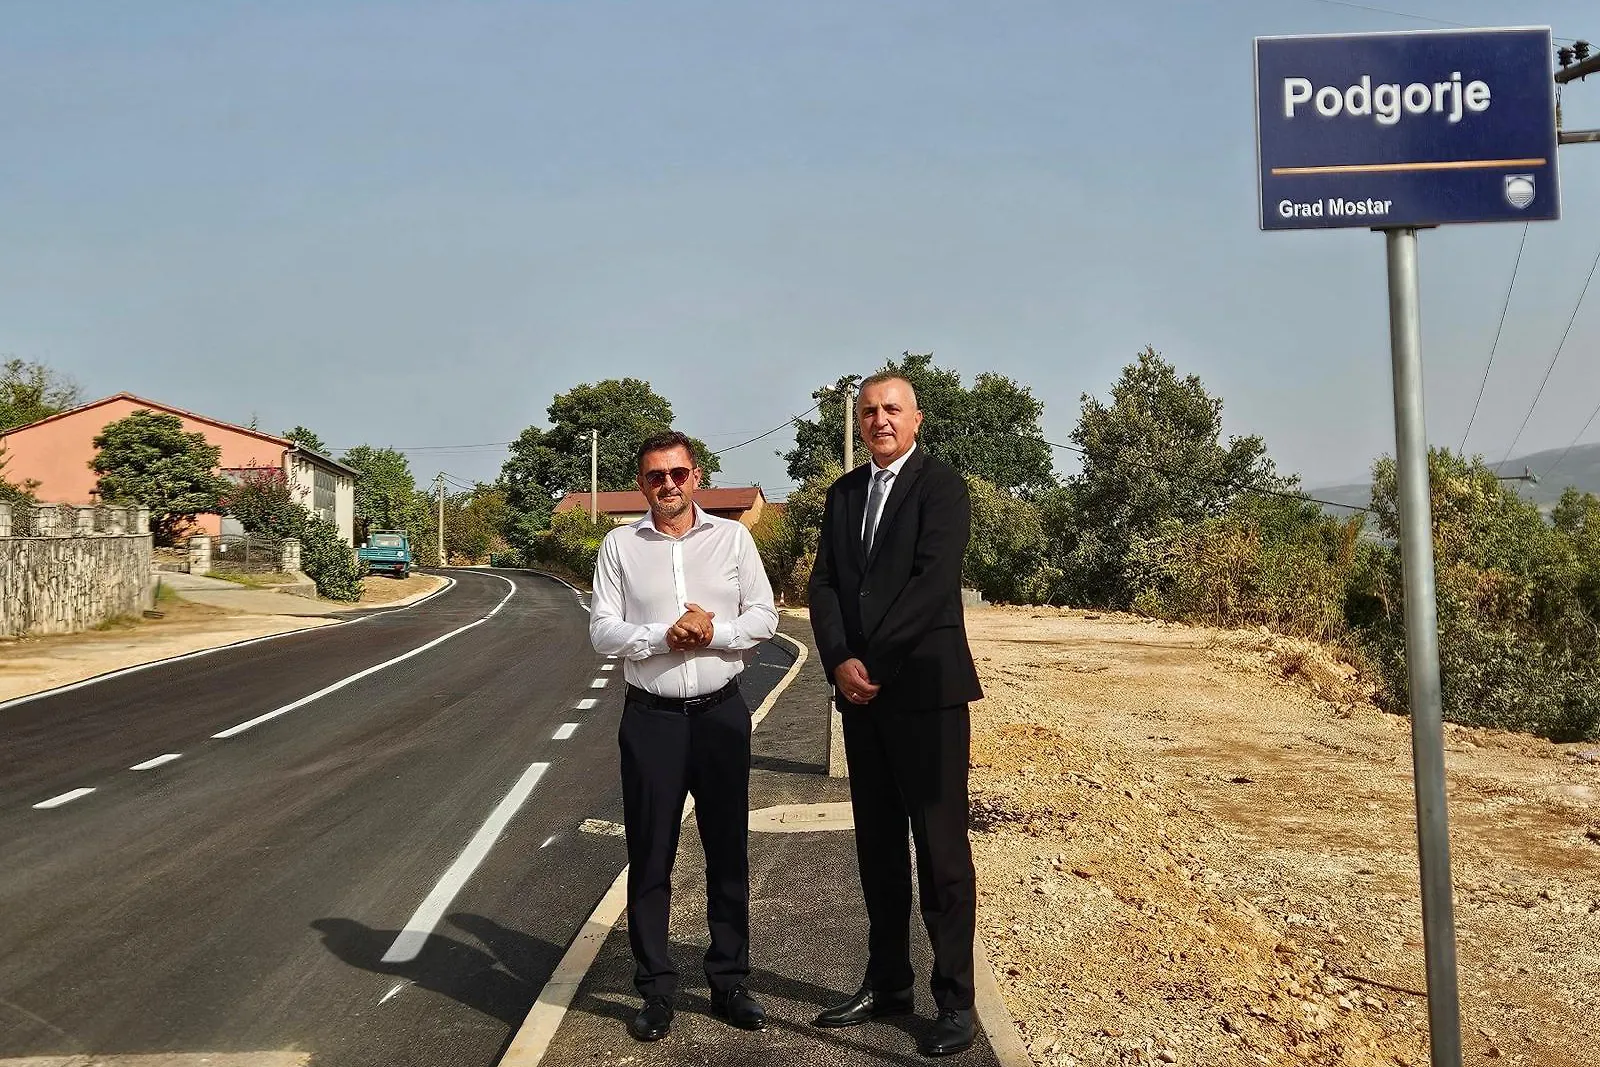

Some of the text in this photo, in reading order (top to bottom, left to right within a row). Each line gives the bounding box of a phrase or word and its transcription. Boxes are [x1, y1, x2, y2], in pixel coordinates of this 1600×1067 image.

[1284, 72, 1490, 124] Podgorje
[1279, 197, 1392, 218] Grad Mostar
